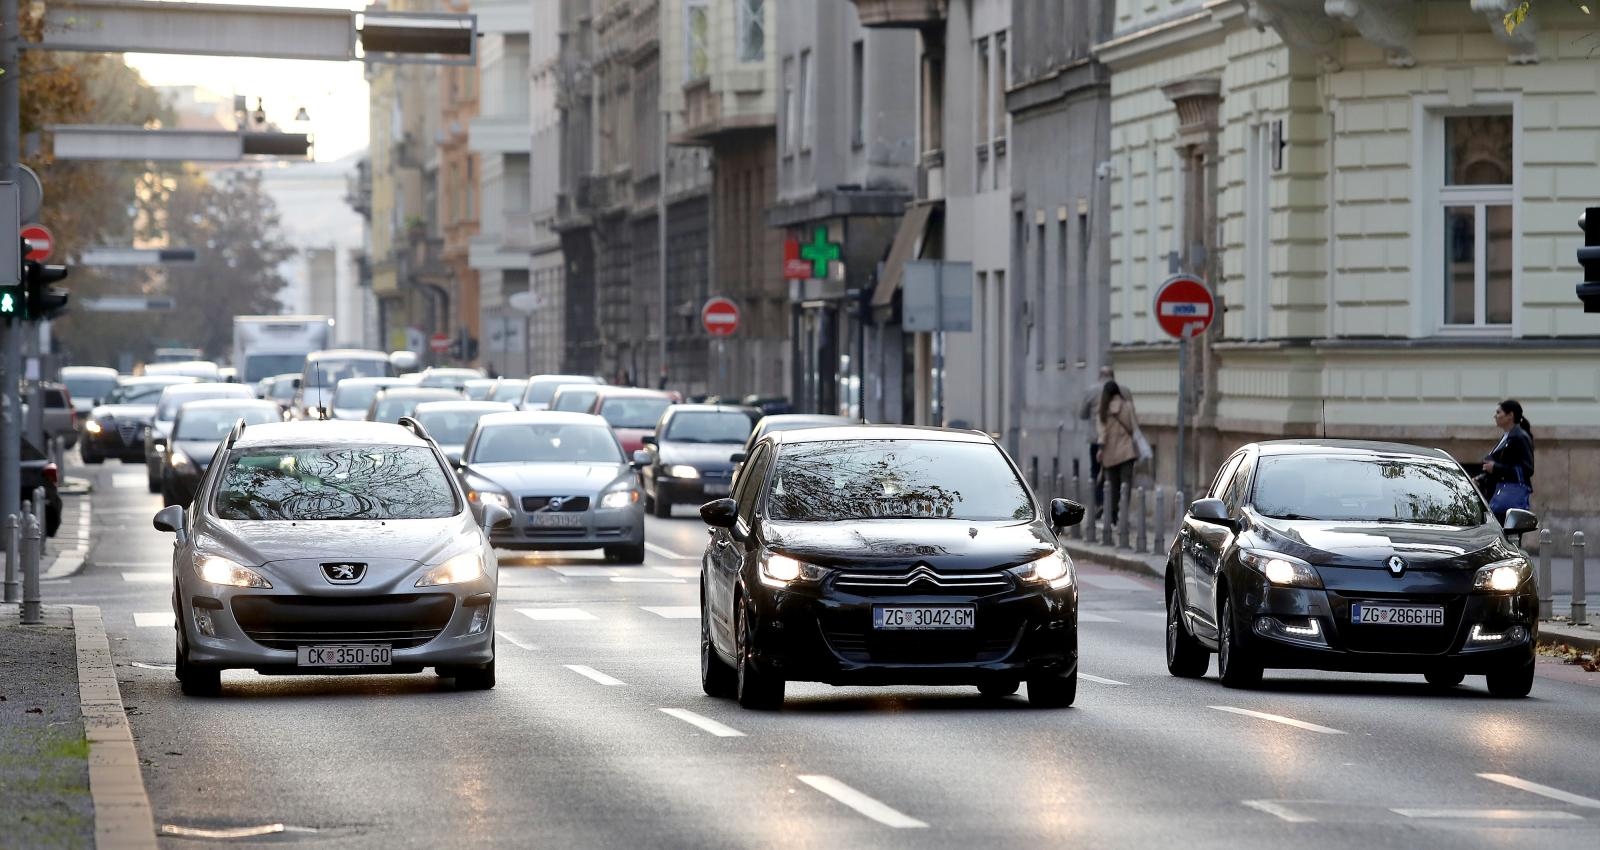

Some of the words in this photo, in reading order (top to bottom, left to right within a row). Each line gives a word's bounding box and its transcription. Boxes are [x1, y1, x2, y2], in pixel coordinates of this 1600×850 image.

[885, 609, 903, 625] ZG
[1362, 607, 1380, 622] ZG
[308, 648, 325, 664] CK
[336, 648, 389, 663] 350-GO
